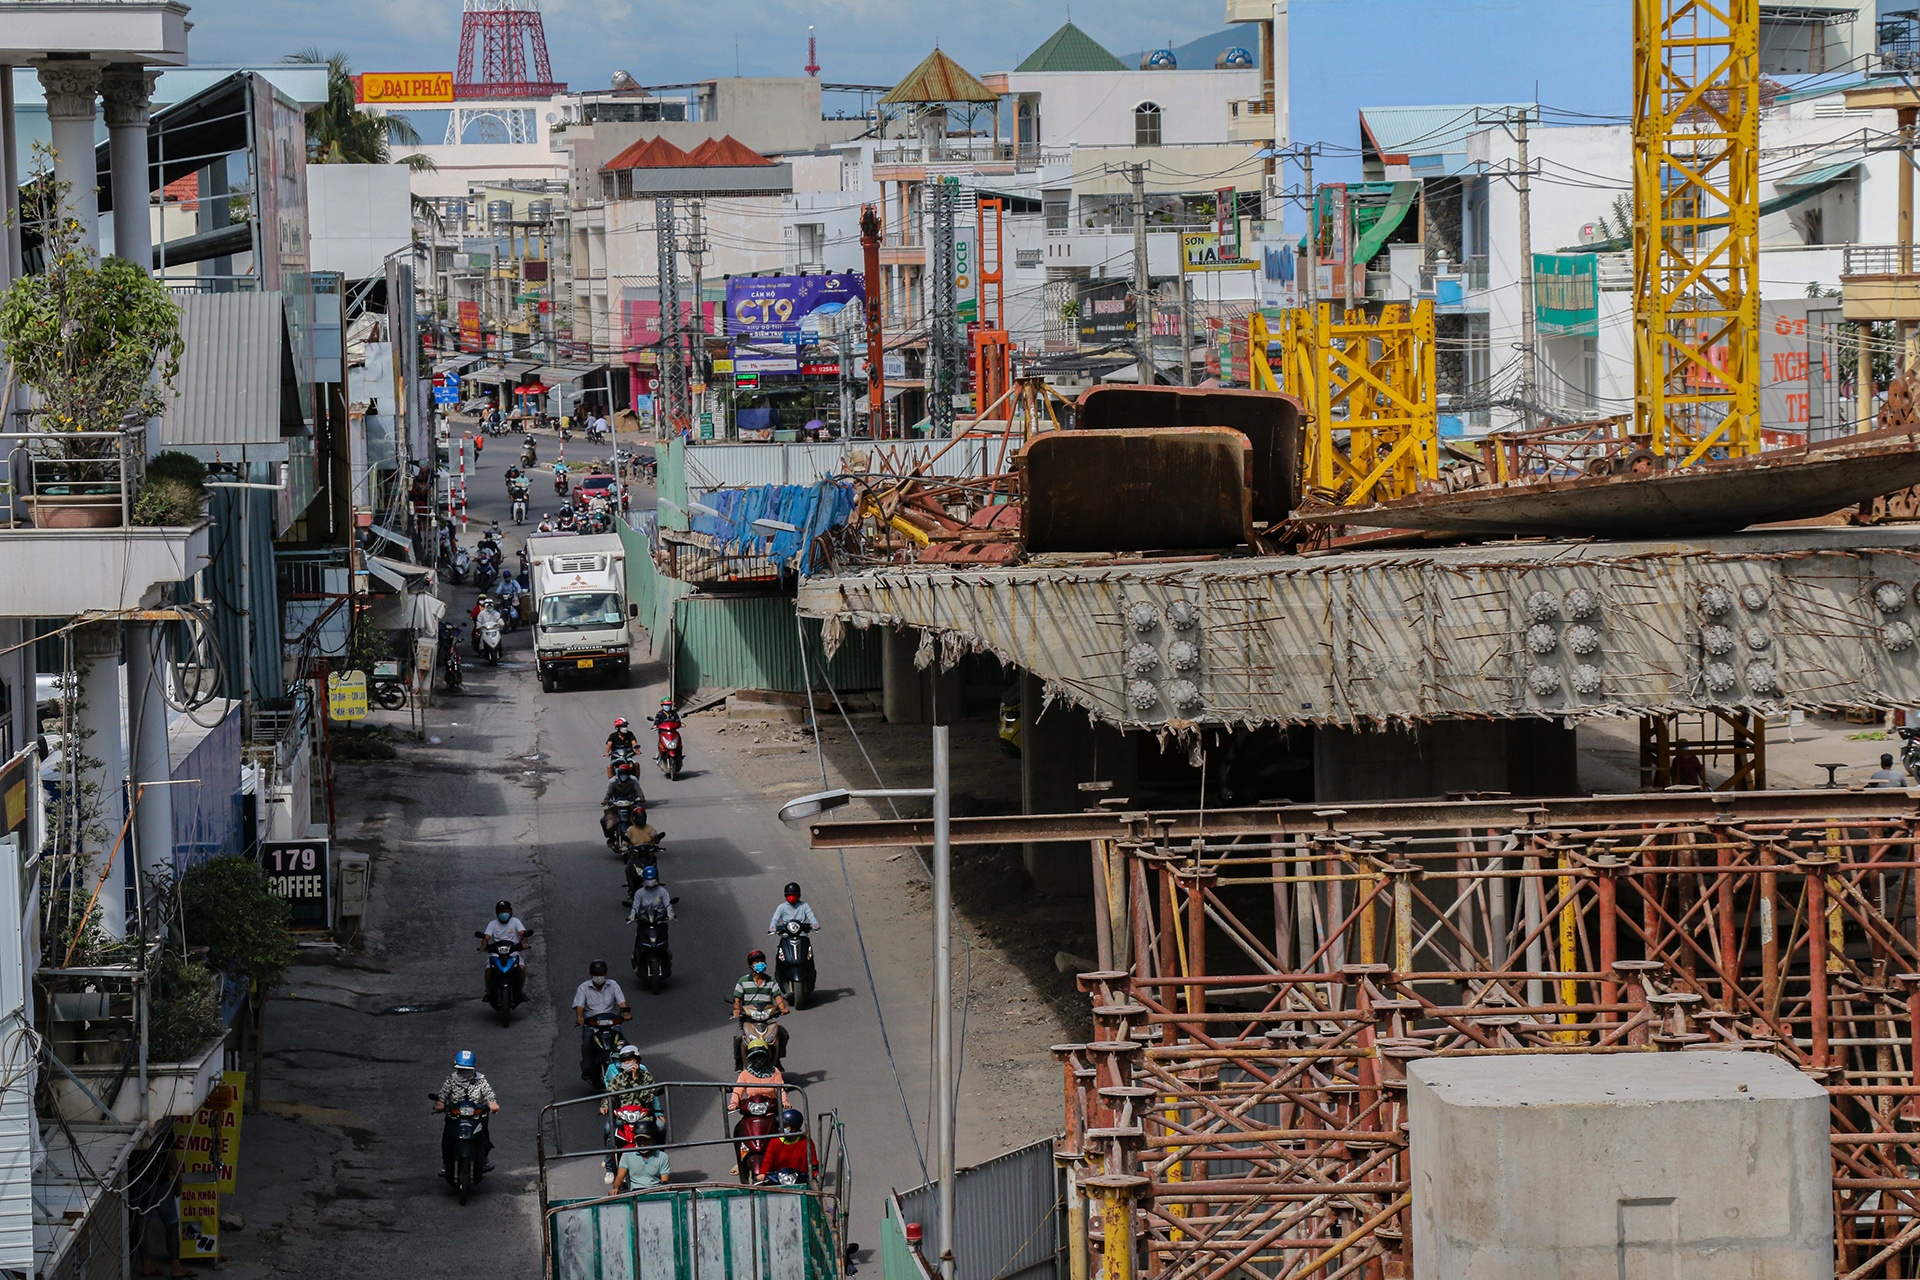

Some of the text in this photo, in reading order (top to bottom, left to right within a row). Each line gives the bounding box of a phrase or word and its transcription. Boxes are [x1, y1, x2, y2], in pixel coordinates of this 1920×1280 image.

[383, 75, 450, 99] ĐẠI PHÁT
[1185, 236, 1204, 246] SƠN
[956, 241, 968, 274] OCB
[735, 298, 793, 325] CT9
[272, 848, 316, 871] 179
[268, 875, 322, 898] COFFEE
[181, 1189, 217, 1201] SỬA KHÓA
[183, 1204, 215, 1217] CẮT CHÌA
